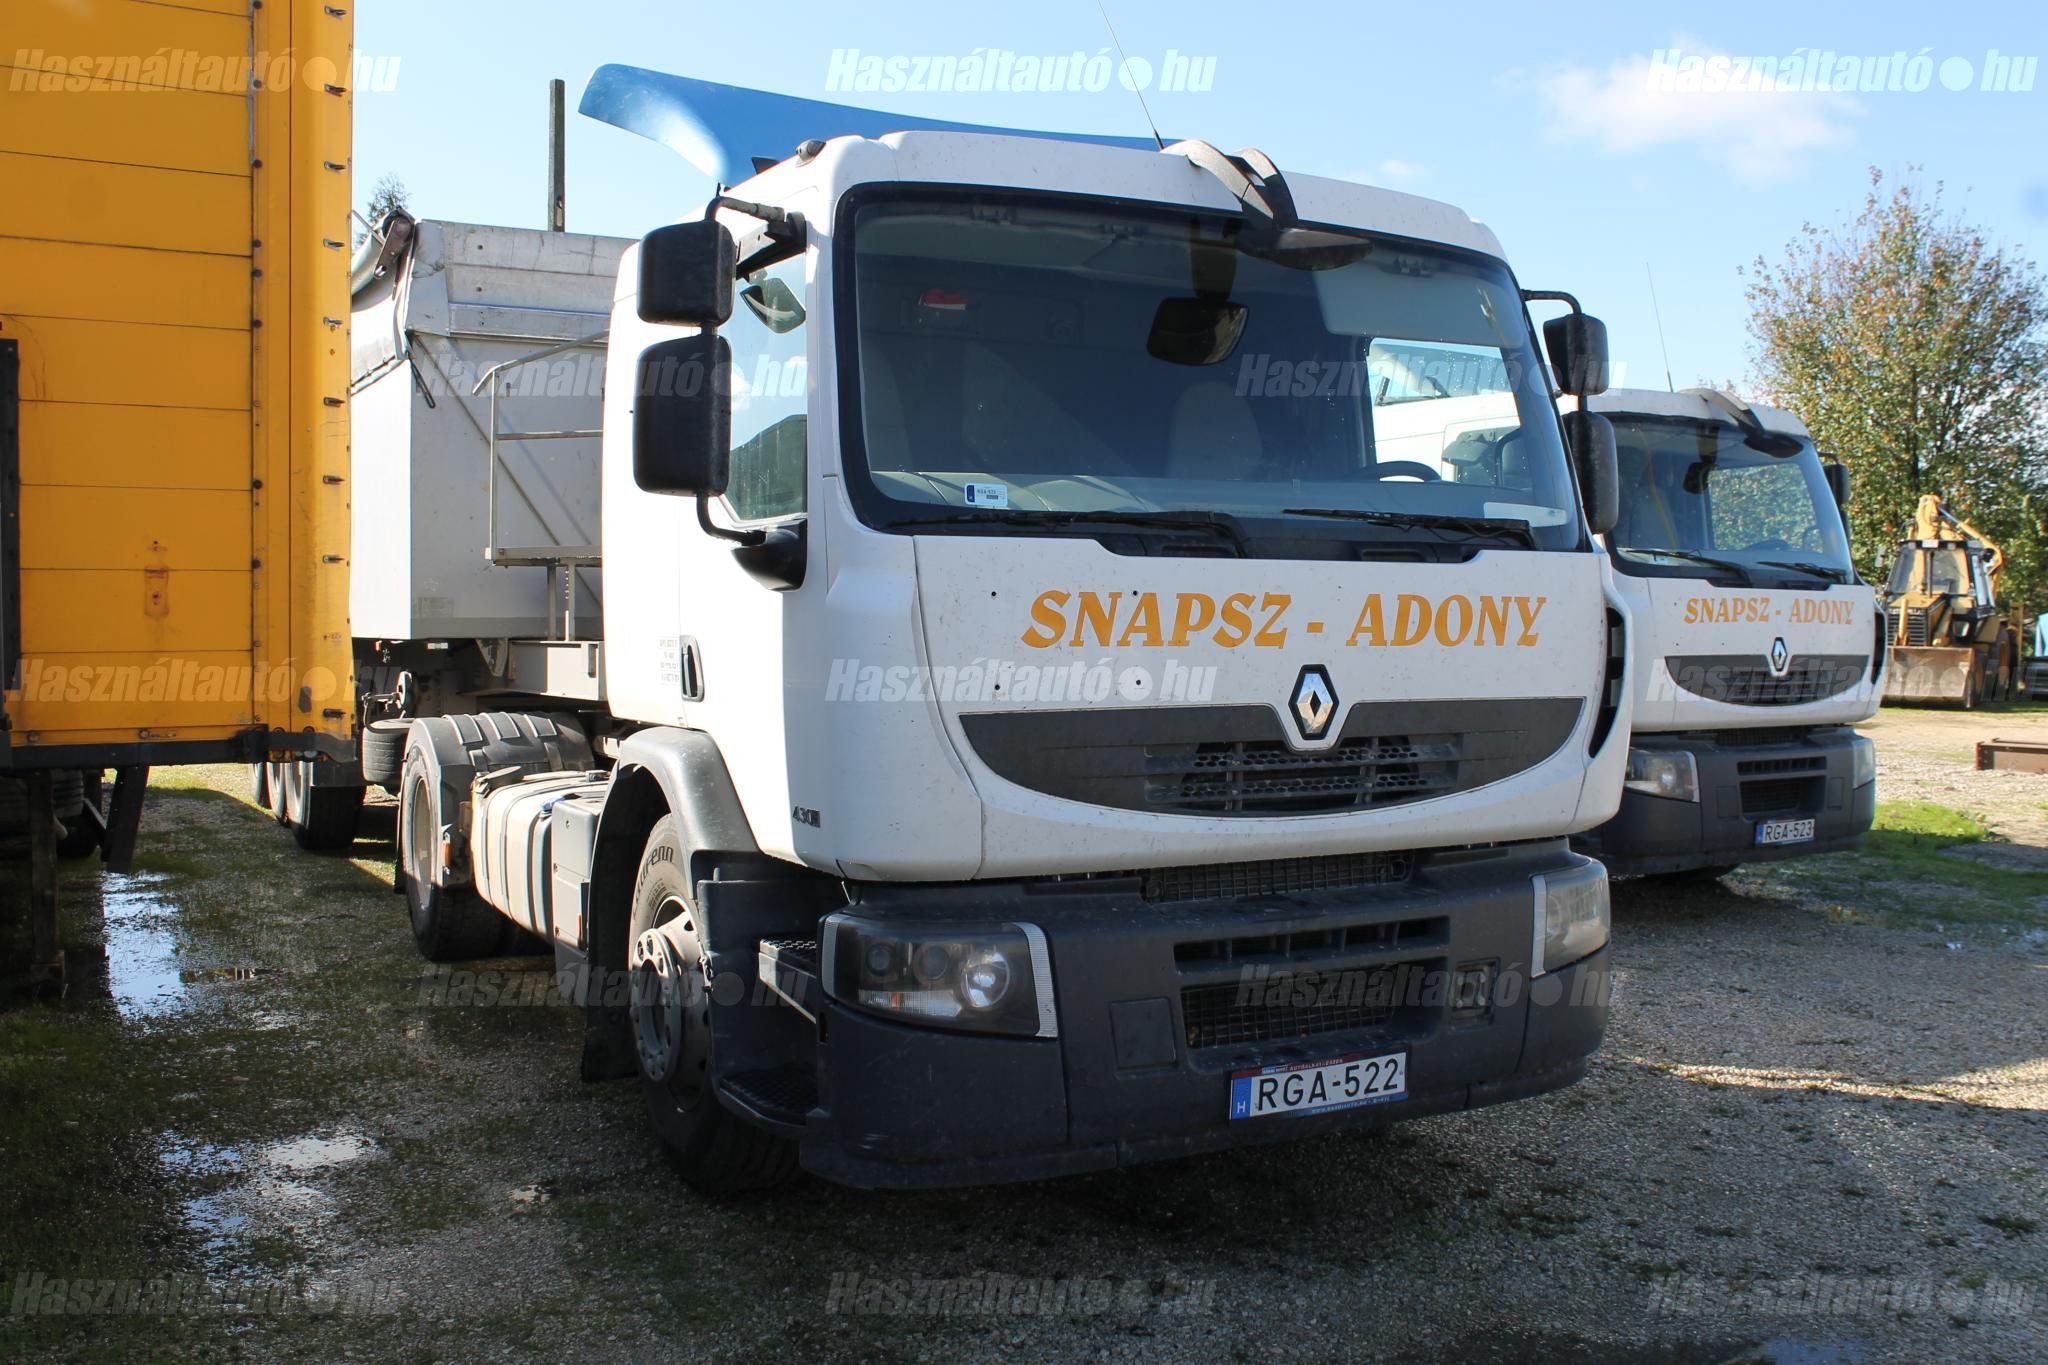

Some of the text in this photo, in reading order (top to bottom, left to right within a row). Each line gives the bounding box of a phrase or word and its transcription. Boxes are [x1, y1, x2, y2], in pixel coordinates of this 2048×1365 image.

[1021, 590, 1547, 649] SNAPSZ - ADONY
[1683, 597, 1770, 624] SNAPSZ
[1788, 599, 1854, 625] ADONY
[1765, 821, 1812, 841] RGA-523
[1258, 1059, 1399, 1111] RGA-522
